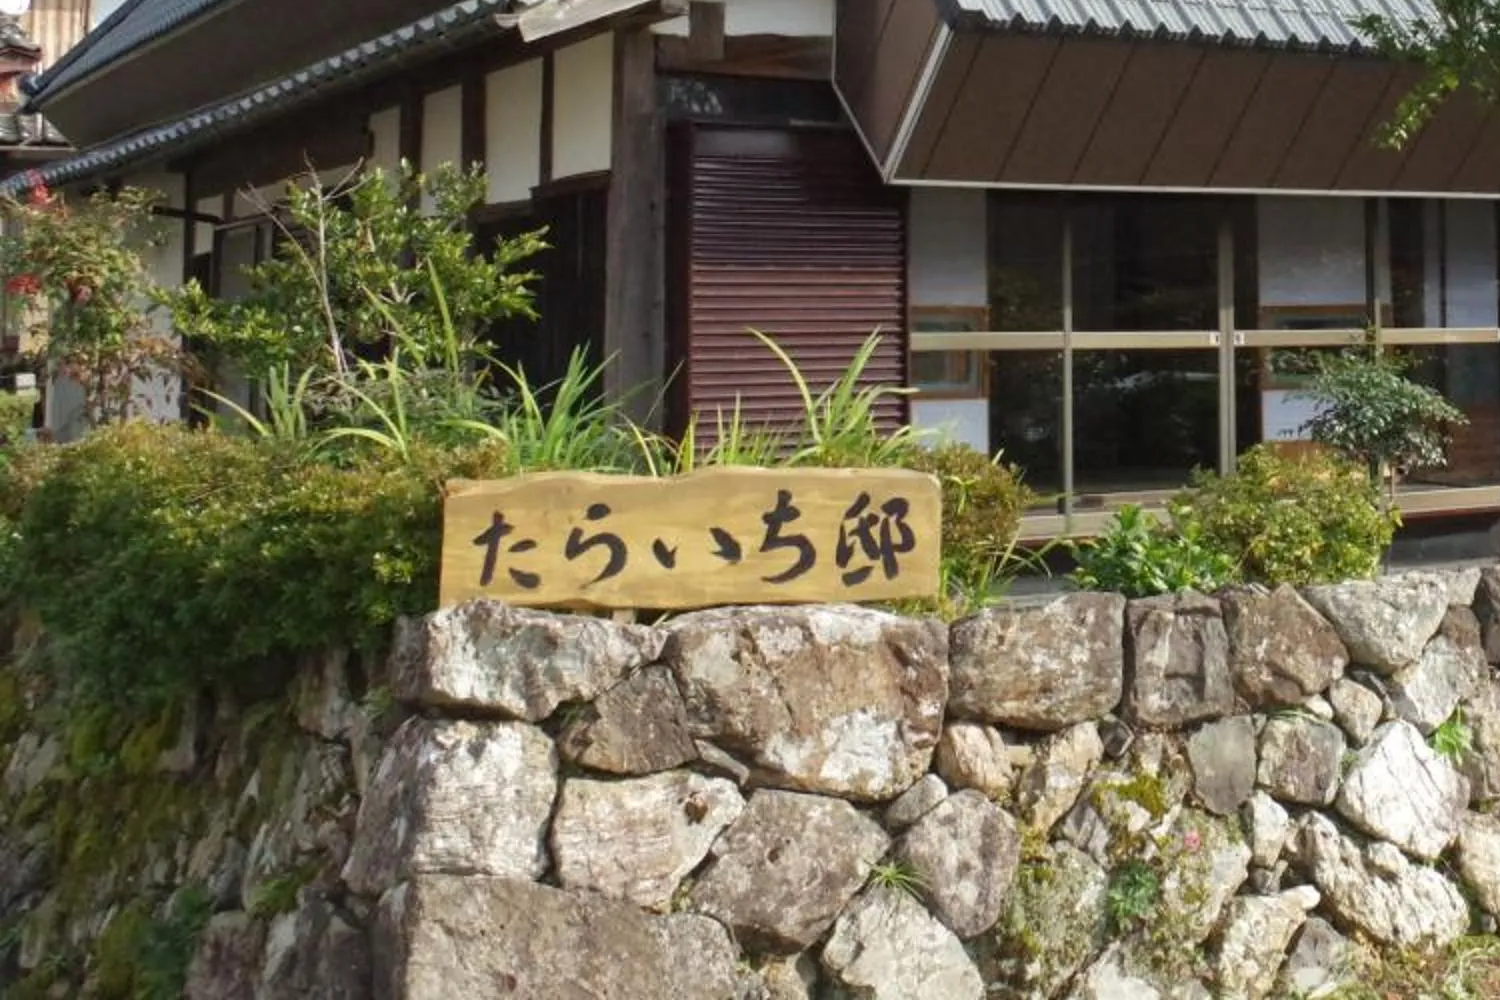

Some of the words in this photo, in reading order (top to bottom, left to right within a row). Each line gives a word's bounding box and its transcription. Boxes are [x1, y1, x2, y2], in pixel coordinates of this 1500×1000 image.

[472, 489, 916, 589] たらいち邸
